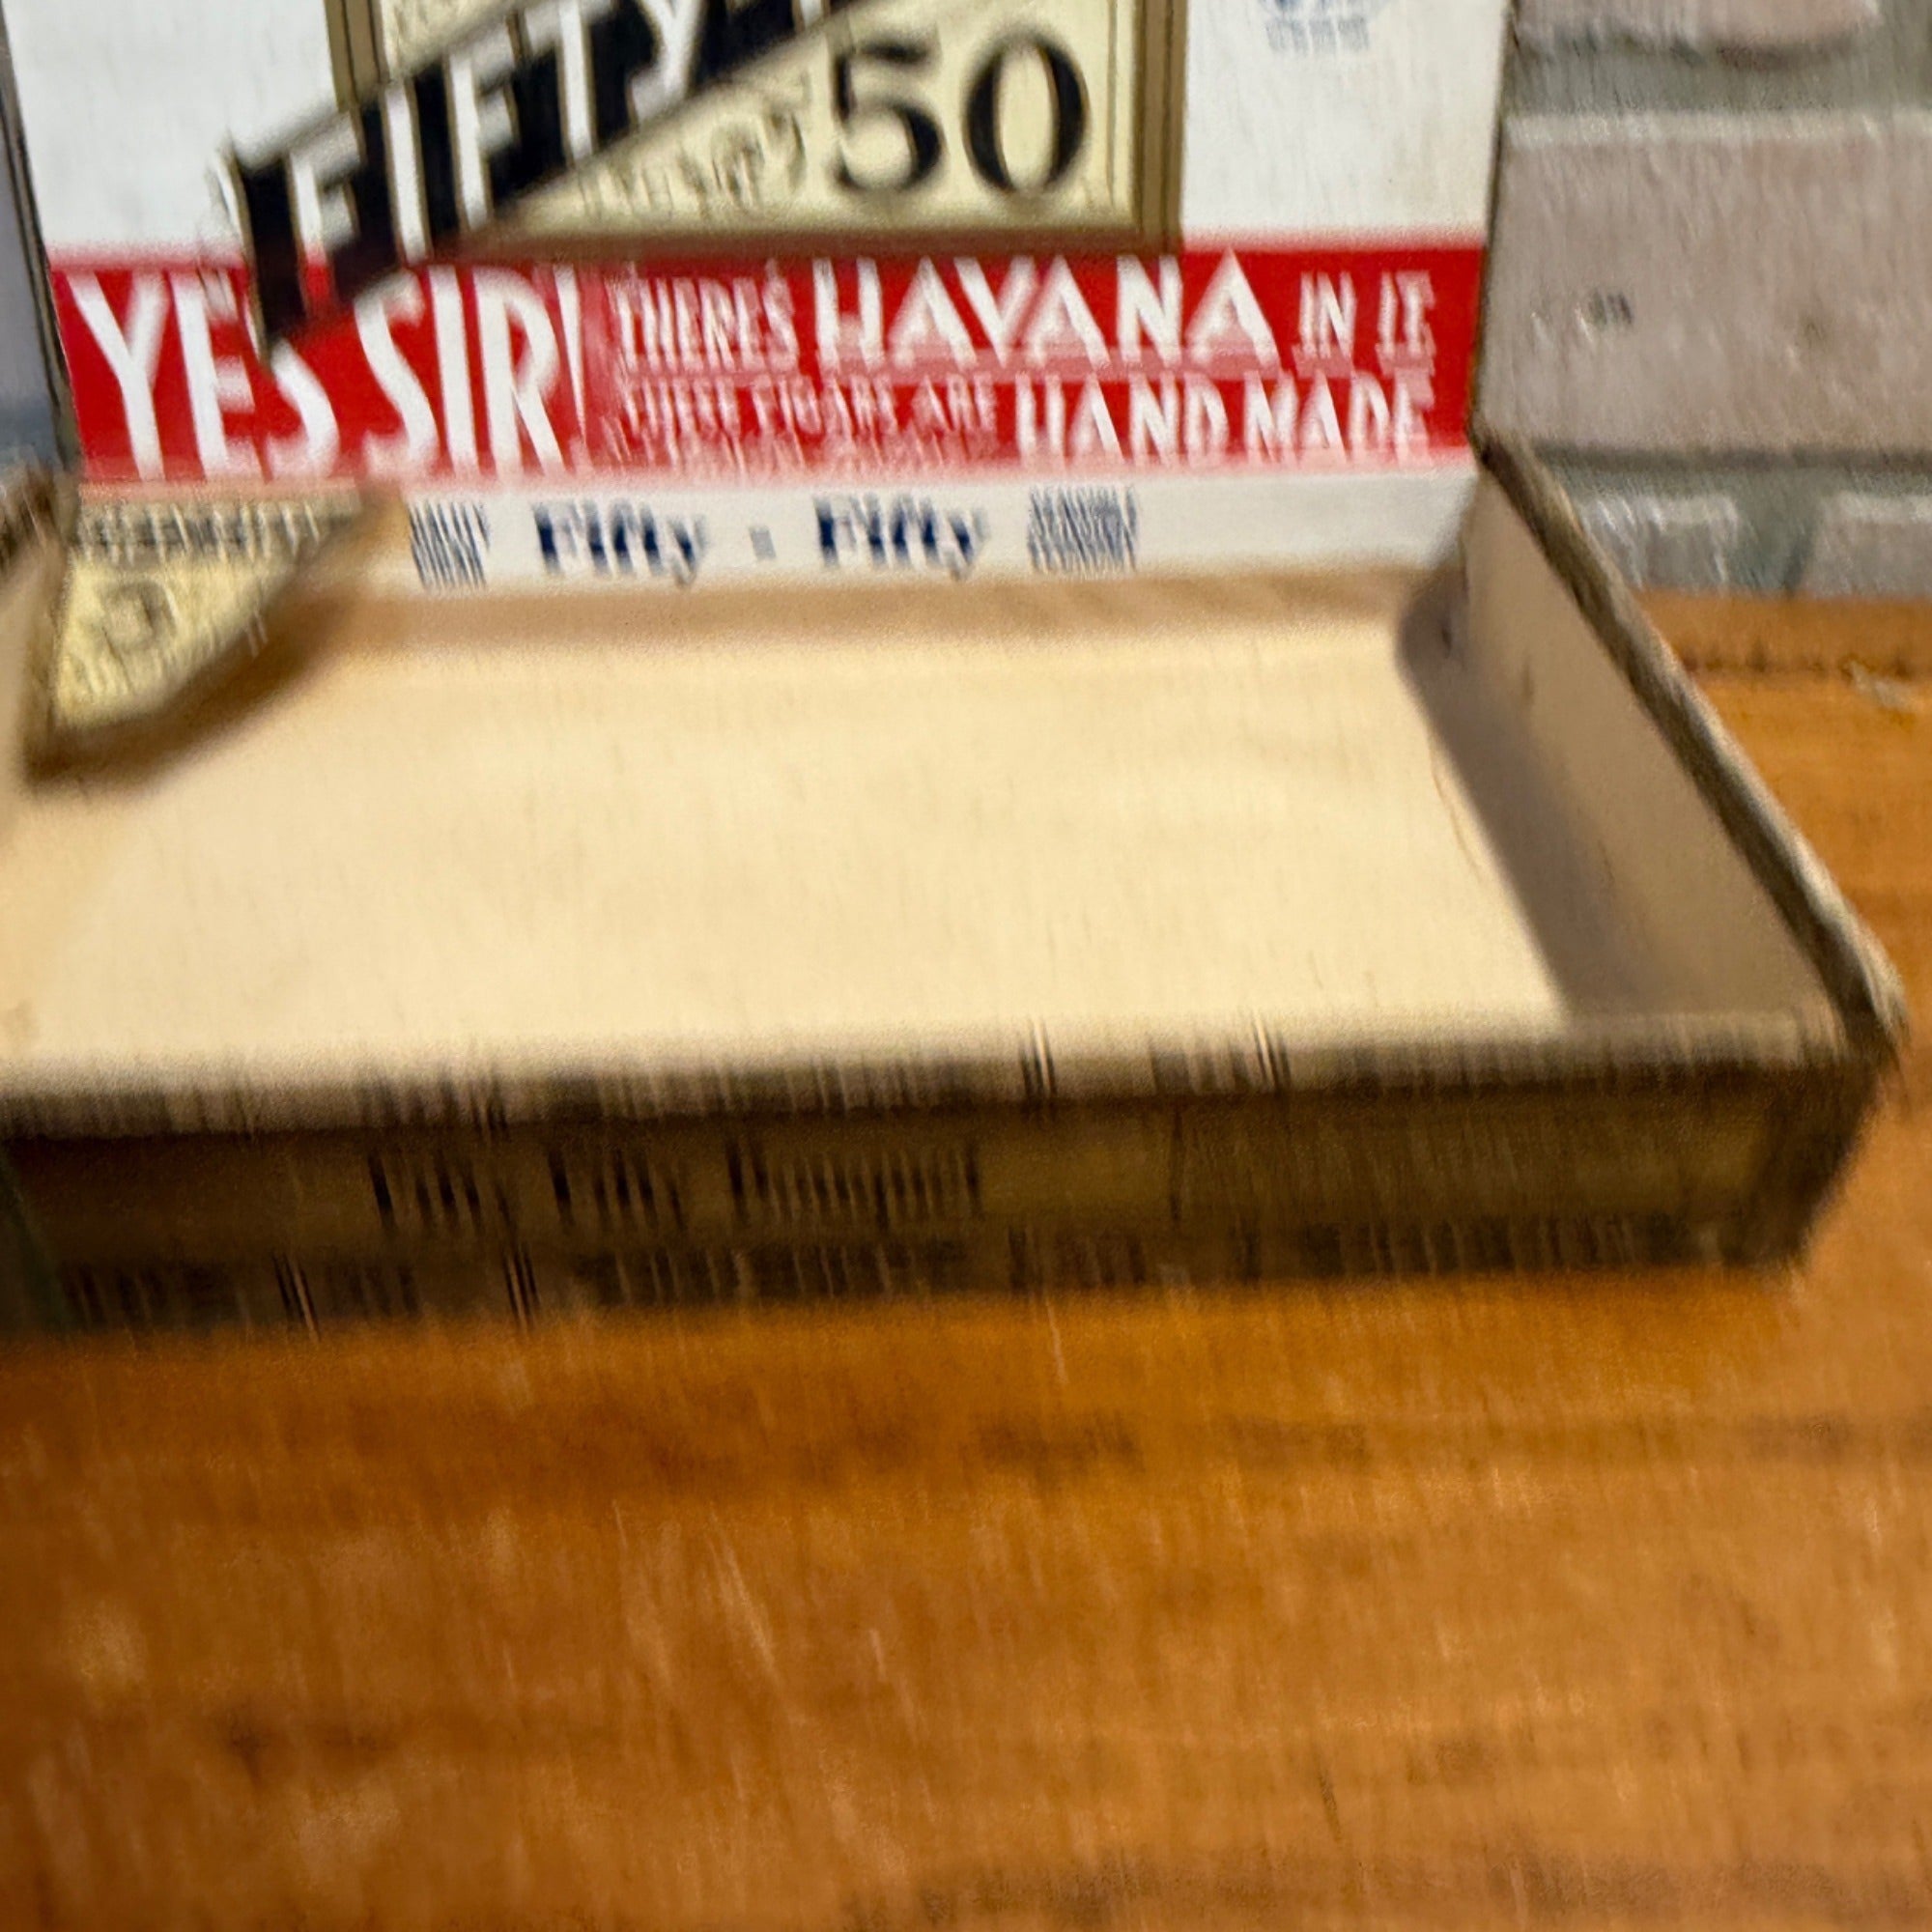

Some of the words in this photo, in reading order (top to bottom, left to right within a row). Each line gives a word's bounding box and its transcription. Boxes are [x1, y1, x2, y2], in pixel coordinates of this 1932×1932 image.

[829, 27, 1092, 199] 50
[66, 269, 340, 481] YES
[354, 265, 591, 481] SIR!
[811, 253, 1279, 369] HAVANA
[1299, 270, 1356, 359] IN
[533, 497, 709, 587] Fifty
[813, 491, 989, 582] Fifty
